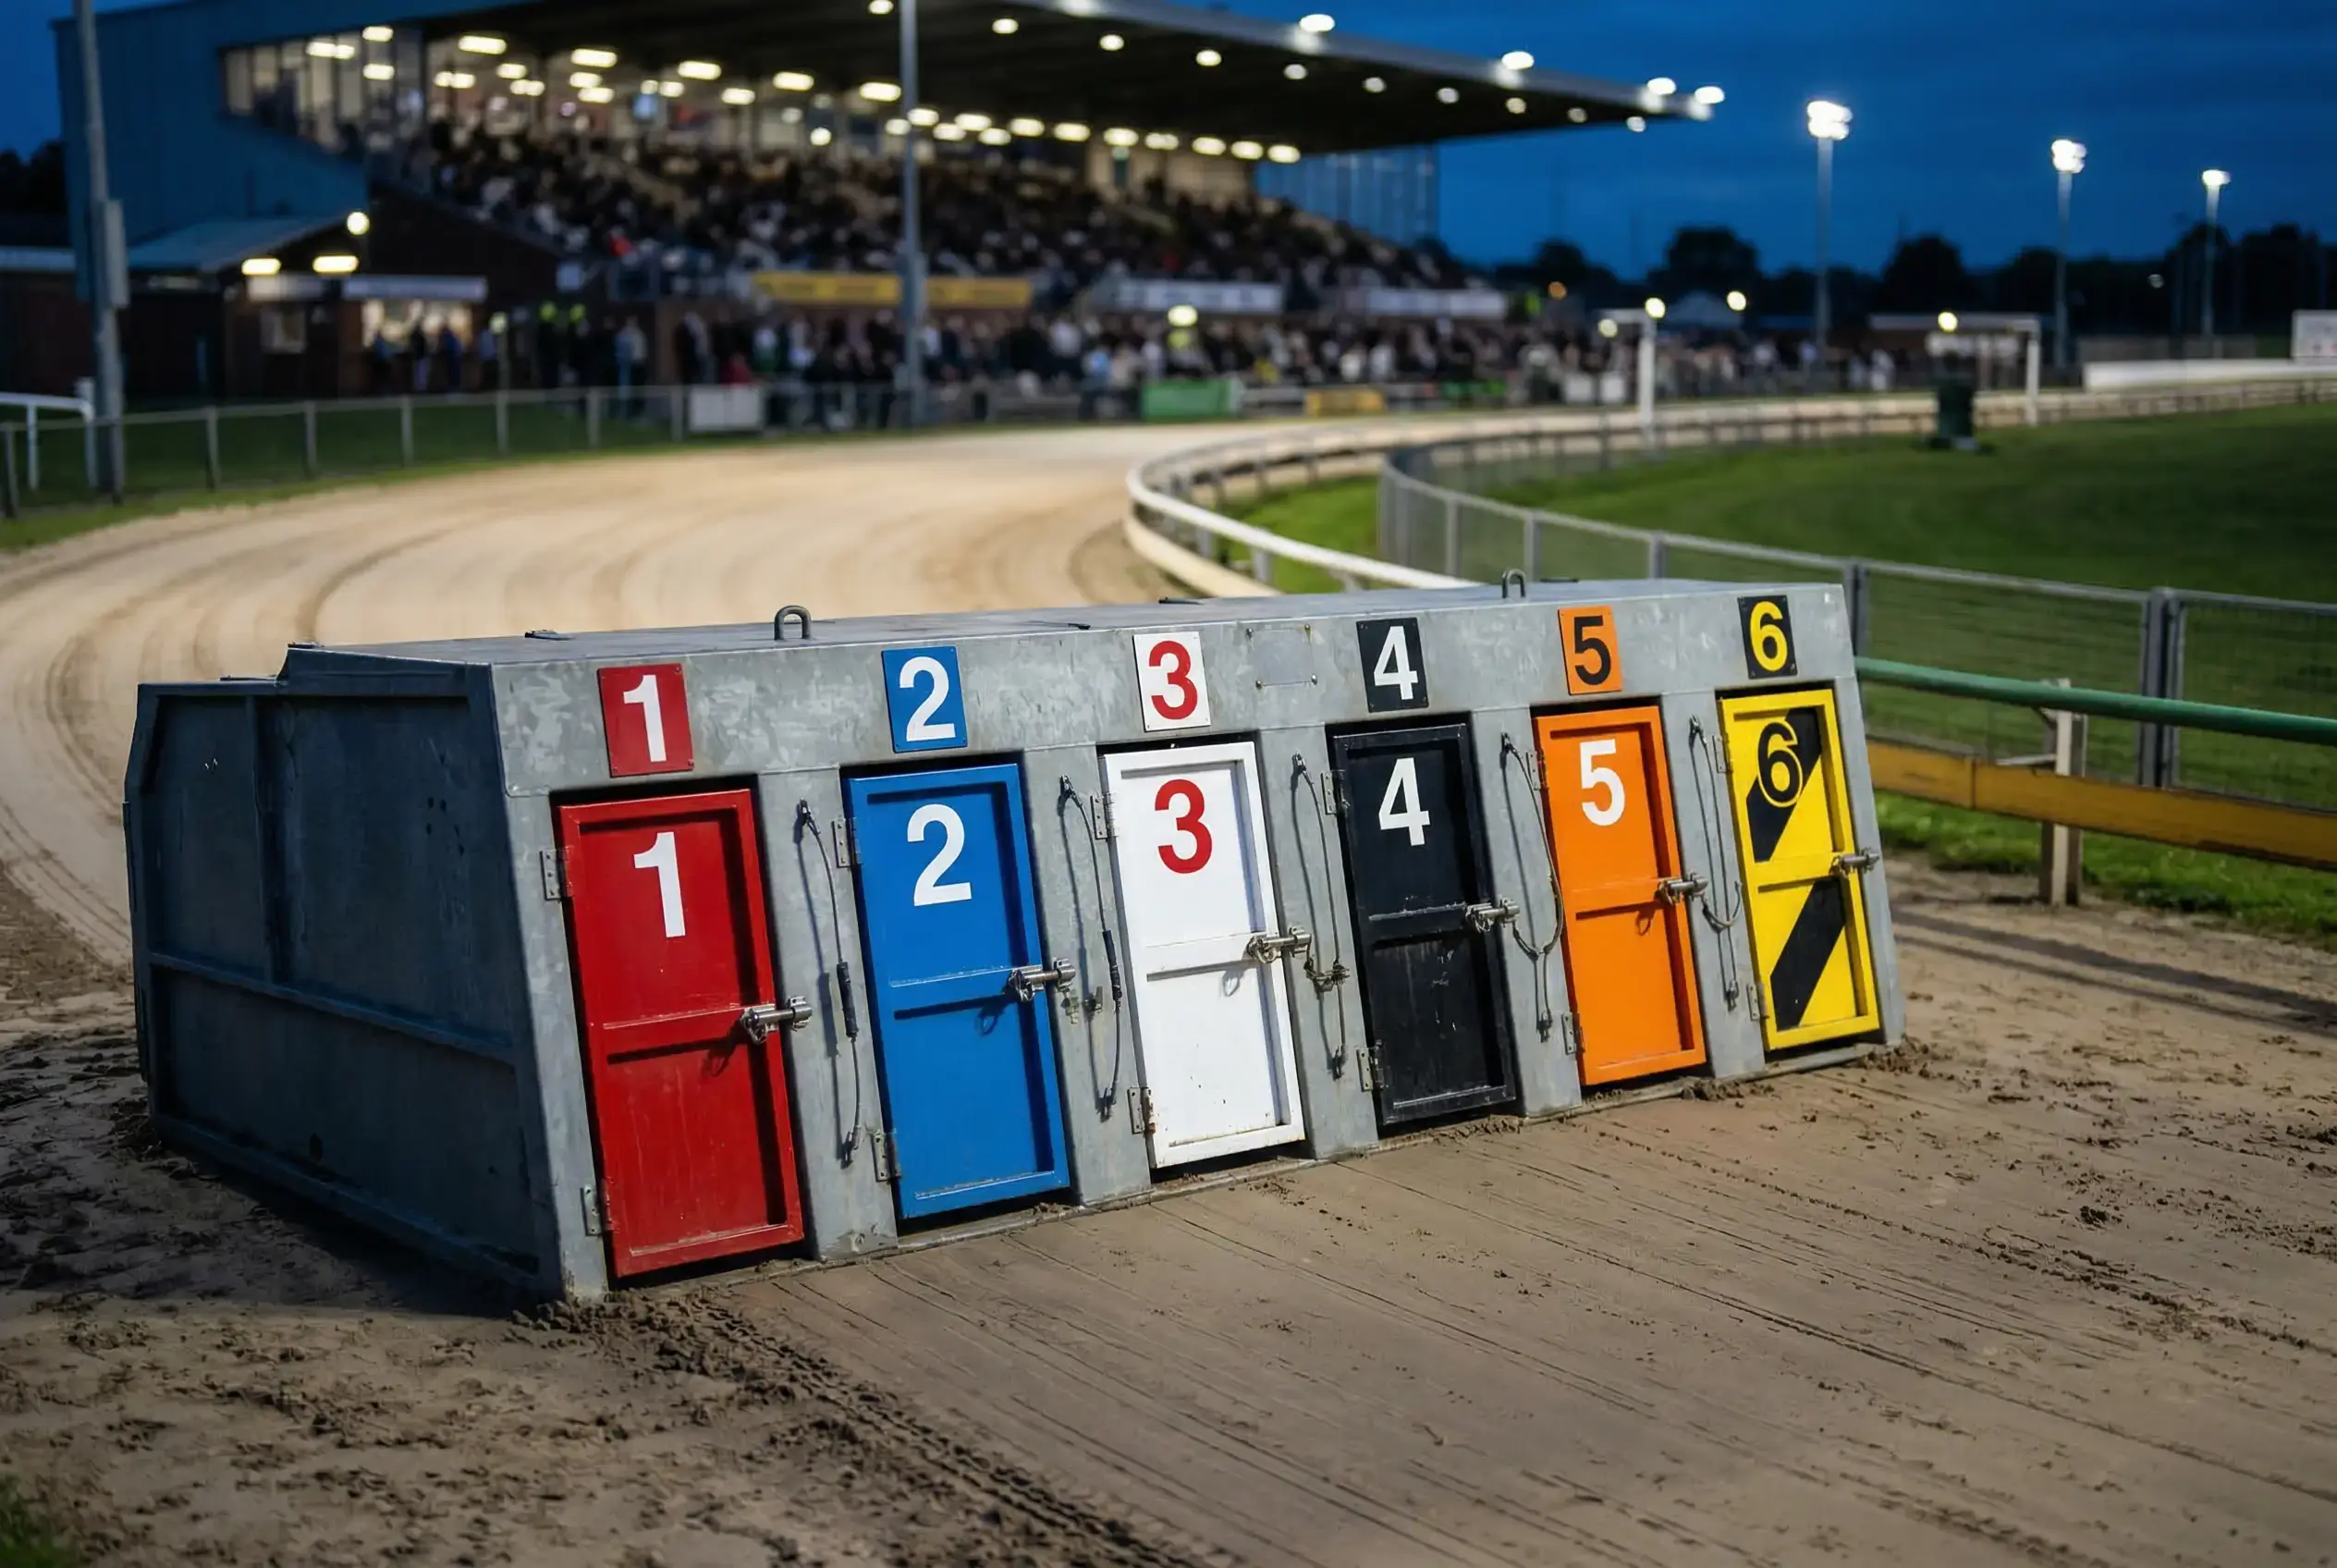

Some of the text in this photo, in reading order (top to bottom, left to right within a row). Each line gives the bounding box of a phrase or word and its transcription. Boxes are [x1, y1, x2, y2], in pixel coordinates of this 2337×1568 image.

[1148, 640, 1198, 720] 3
[1373, 625, 1419, 701] 4
[1573, 616, 1611, 685] 5
[1749, 601, 1788, 672] 6
[624, 674, 667, 763] 1
[899, 655, 956, 742] 2
[1378, 757, 1431, 847] 4
[1579, 739, 1625, 827] 5
[1757, 722, 1801, 802] 6
[907, 803, 973, 907] 2
[1155, 778, 1213, 874] 3
[633, 831, 686, 938] 1
